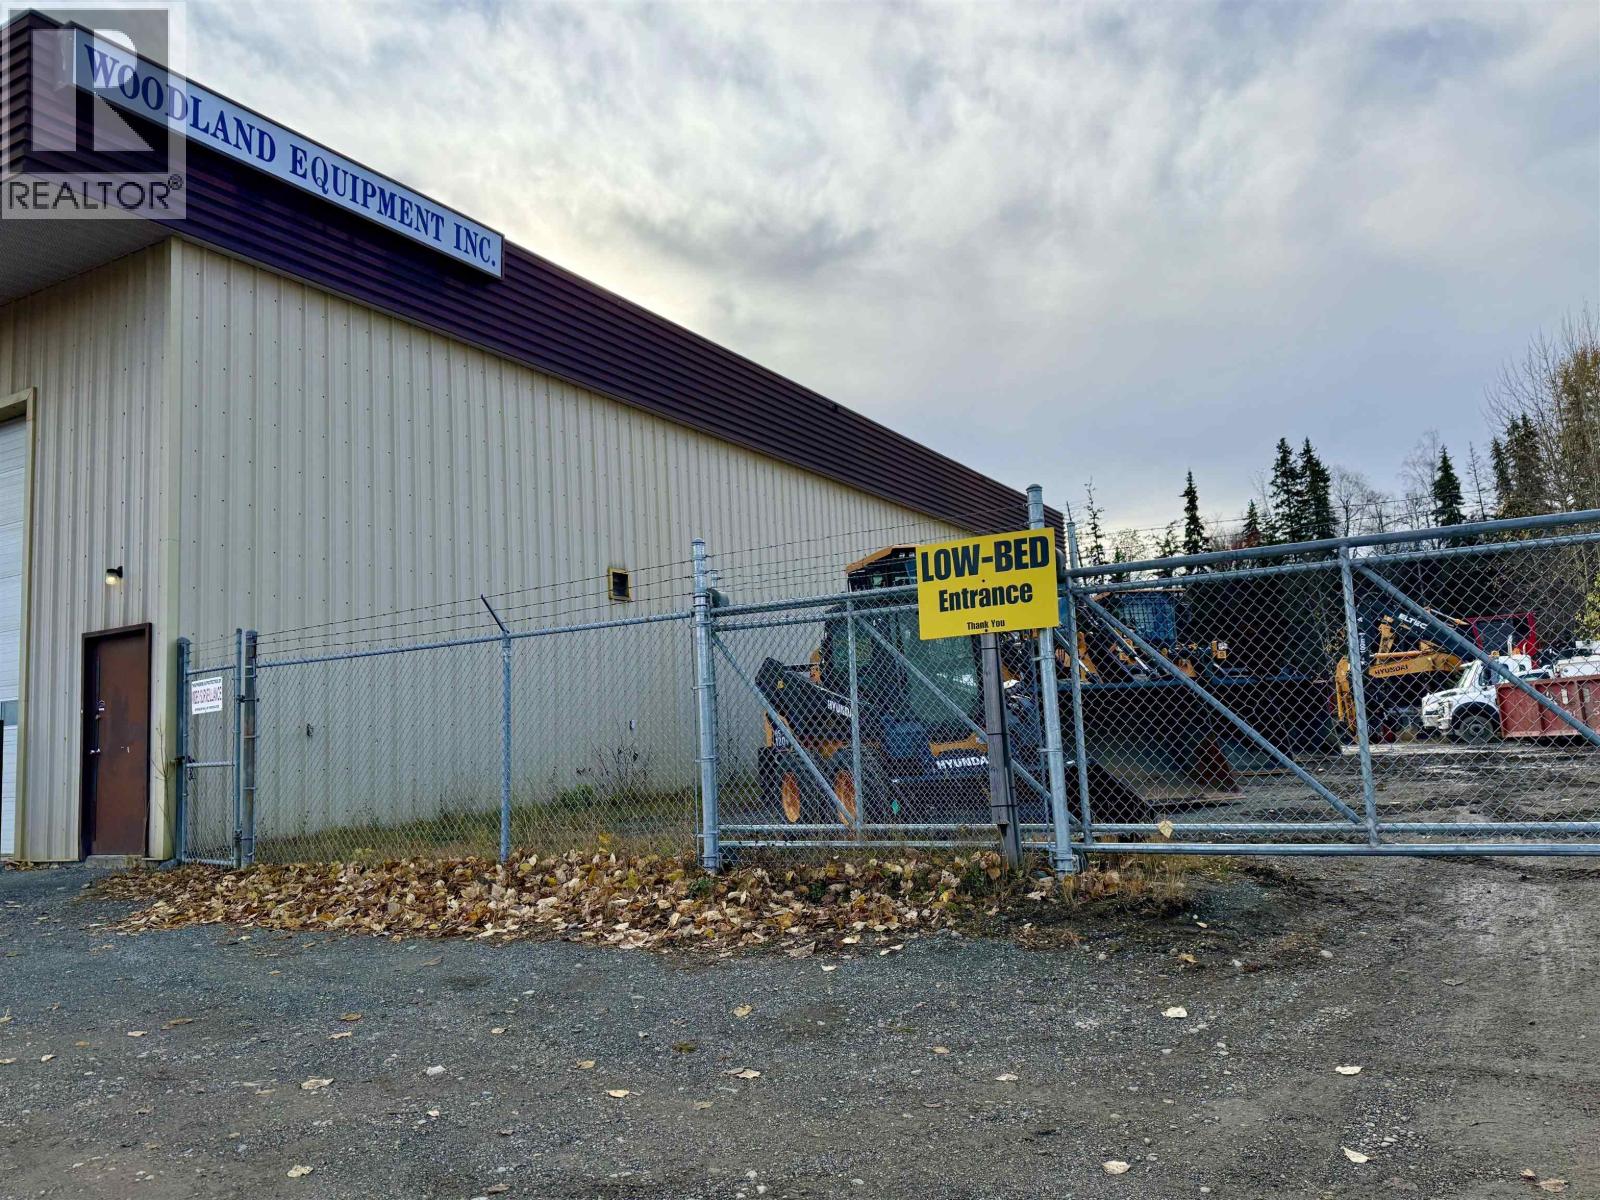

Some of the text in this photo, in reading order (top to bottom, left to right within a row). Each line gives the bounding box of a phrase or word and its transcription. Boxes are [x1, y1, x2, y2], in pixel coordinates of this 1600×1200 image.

[84, 44, 496, 267] WOODLAND EQUIPMENT INC.
[921, 536, 1050, 582] LOW-BED
[939, 583, 1033, 612] Entrance
[967, 619, 1005, 630] Thank You
[1374, 664, 1409, 675] HYUNDAI
[936, 756, 989, 769] HYUNDA
